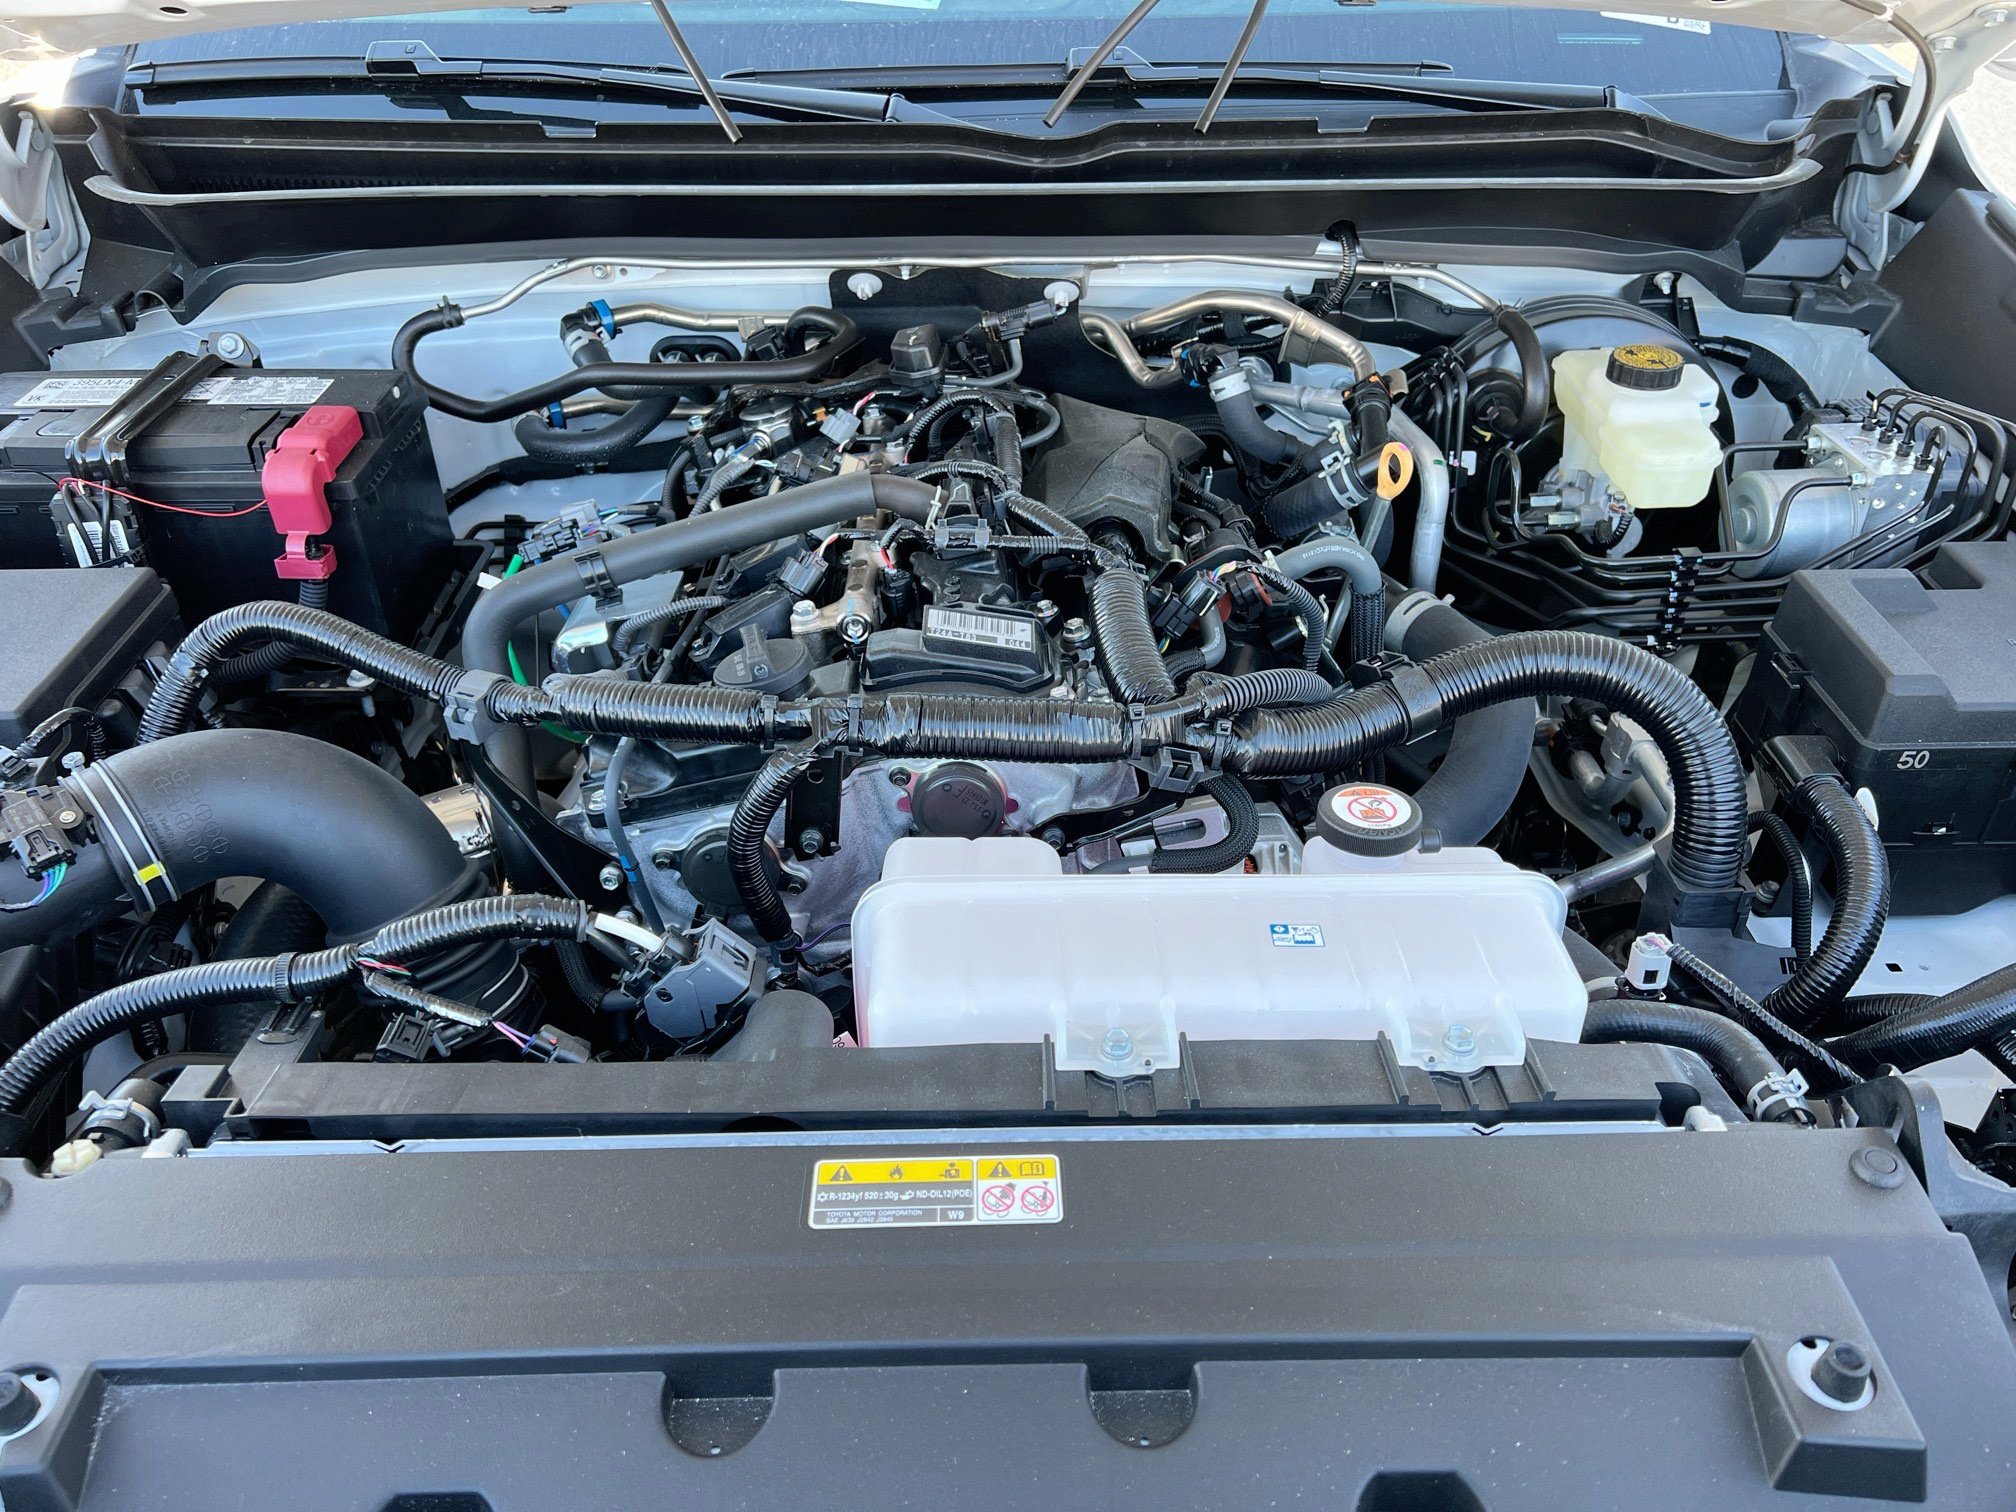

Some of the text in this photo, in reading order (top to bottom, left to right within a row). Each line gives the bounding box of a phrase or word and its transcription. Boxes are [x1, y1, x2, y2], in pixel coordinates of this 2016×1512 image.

[1897, 750, 1930, 769] 50
[829, 1188, 973, 1201] R-1234yf 520±30g ND-OIL12(POE)
[948, 1210, 965, 1220] W9
